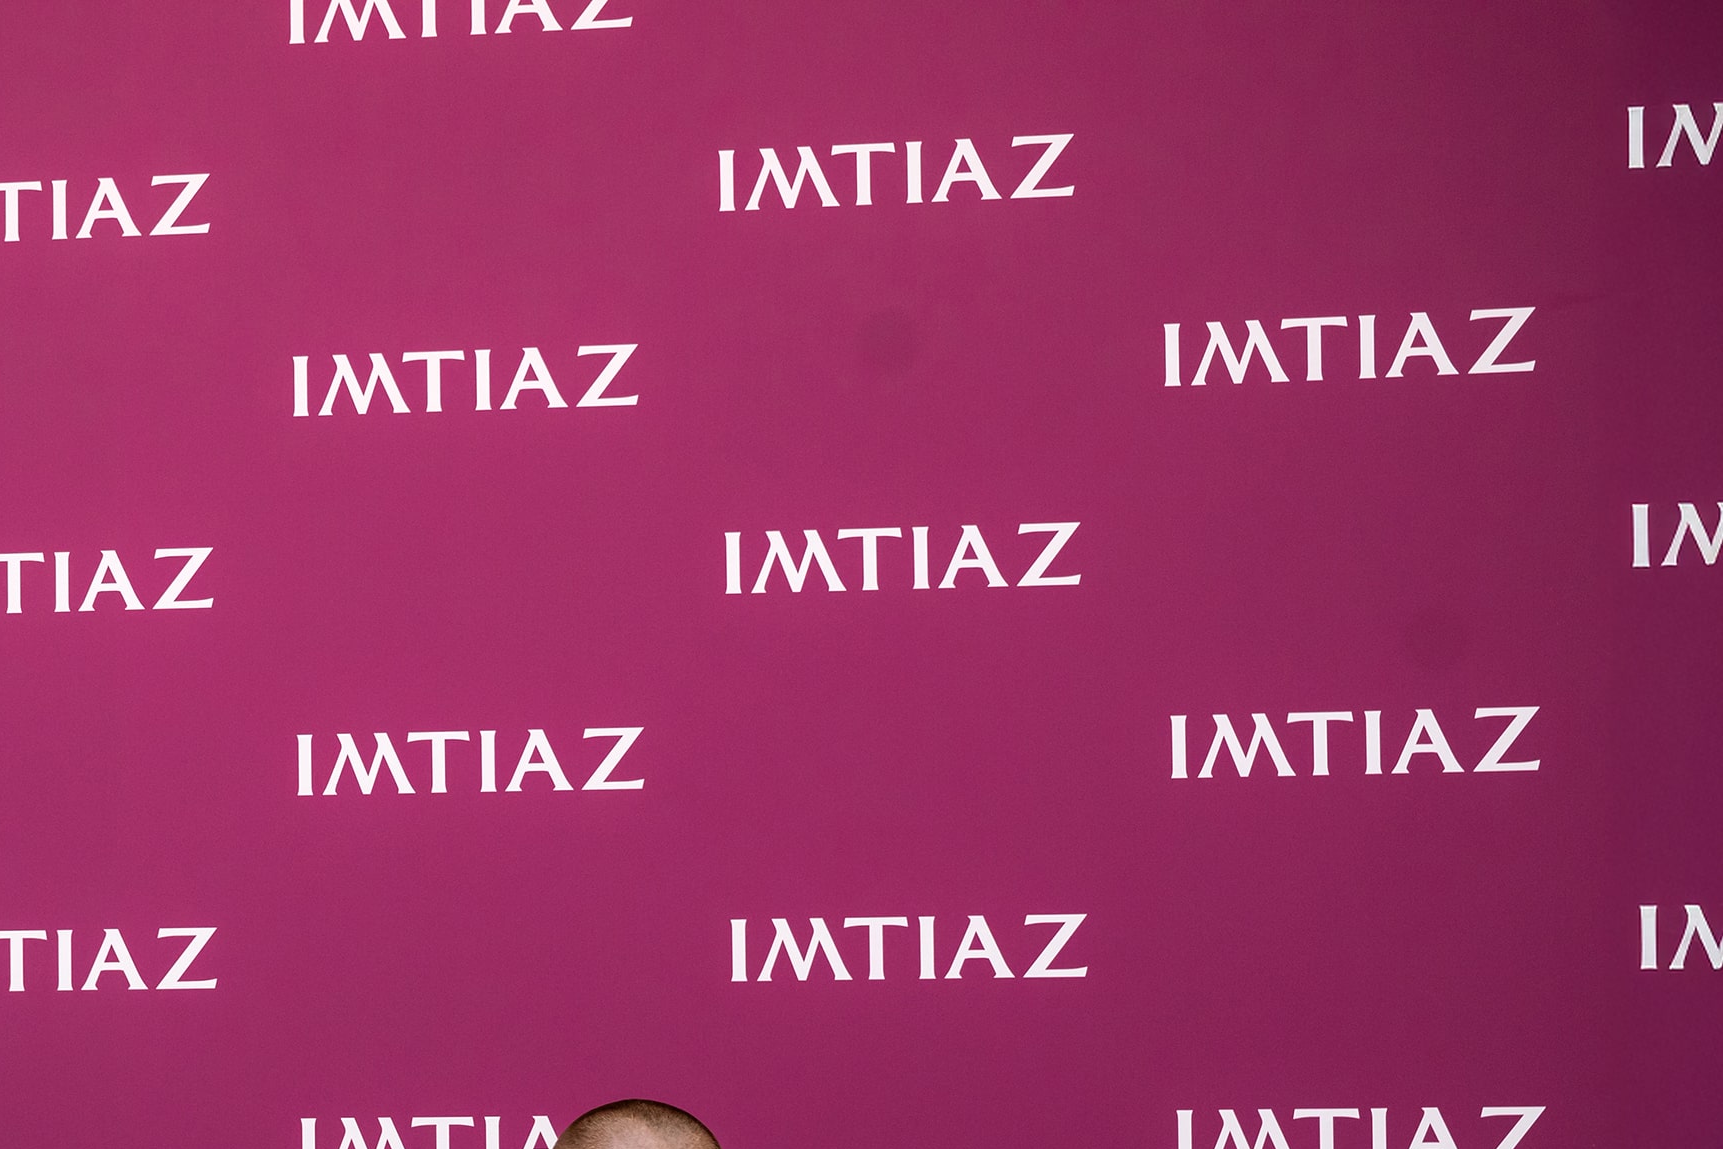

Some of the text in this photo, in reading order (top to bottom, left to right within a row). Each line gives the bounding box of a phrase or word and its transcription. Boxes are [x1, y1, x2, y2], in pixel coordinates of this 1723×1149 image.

[718, 134, 1074, 211] IMTIAZ
[293, 344, 638, 416] IMTIAZ
[1164, 307, 1535, 386] IMTIAZ
[725, 522, 1081, 594] IMTIAZ
[297, 727, 644, 796] IMTIAZ
[1170, 706, 1540, 778] IMTIAZ
[731, 914, 1088, 981] IMTIAZ
